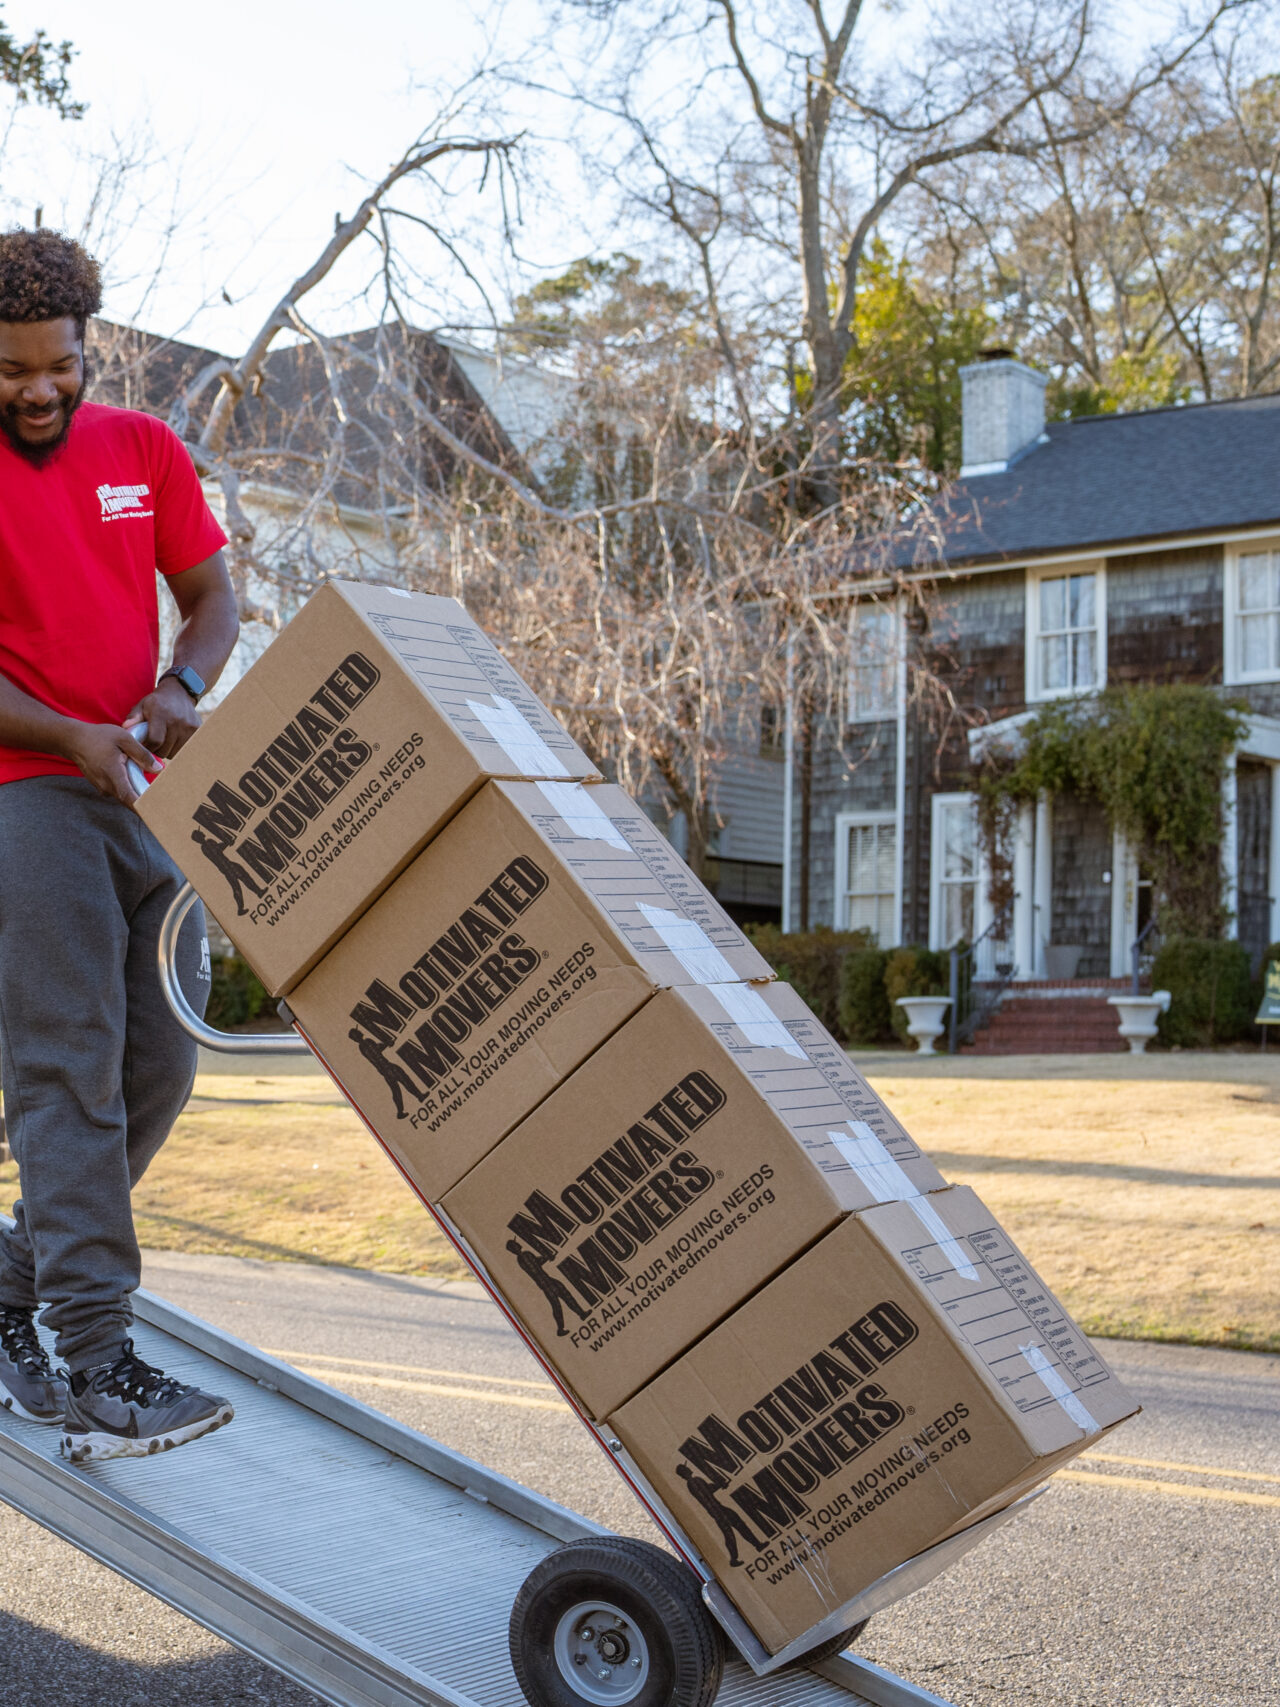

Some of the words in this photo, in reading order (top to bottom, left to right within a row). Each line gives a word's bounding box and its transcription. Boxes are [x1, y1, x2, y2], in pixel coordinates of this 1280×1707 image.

[192, 651, 381, 842] MOTIVATED
[236, 728, 373, 885] MOVERS
[250, 894, 277, 925] FOR
[277, 871, 301, 899] ALL
[297, 832, 334, 871] YOUR
[332, 779, 380, 835] MOVING
[379, 732, 424, 781] NEEDS
[266, 754, 426, 927] www.motivatedmovers.org
[349, 855, 549, 1044] MOTIVATED
[396, 933, 541, 1092] MOVERS
[410, 1099, 438, 1130] FOR
[438, 1077, 464, 1104] ALL
[460, 1039, 500, 1077] YOUR
[499, 987, 549, 1041] MOVING
[548, 942, 596, 992] NEEDS
[427, 964, 597, 1133] www.motivatedmovers.org
[507, 1069, 727, 1259] MOTIVATED
[556, 1150, 715, 1310] MOVERS
[570, 1317, 602, 1348] FOR
[602, 1296, 629, 1323] ALL
[625, 1259, 669, 1297] YOUR
[666, 1209, 724, 1263] MOVING
[721, 1164, 775, 1213] NEEDS
[589, 1187, 776, 1353] www.motivatedmovers.org
[678, 1300, 919, 1487] MOTIVATED
[729, 1383, 905, 1542] MOVERS
[745, 1548, 780, 1581] FOR
[779, 1528, 813, 1554] ALL
[807, 1493, 854, 1531] YOUR
[850, 1443, 917, 1501] MOVING
[912, 1402, 970, 1450] NEEDS
[766, 1426, 971, 1586] www.motivatedmovers.org
